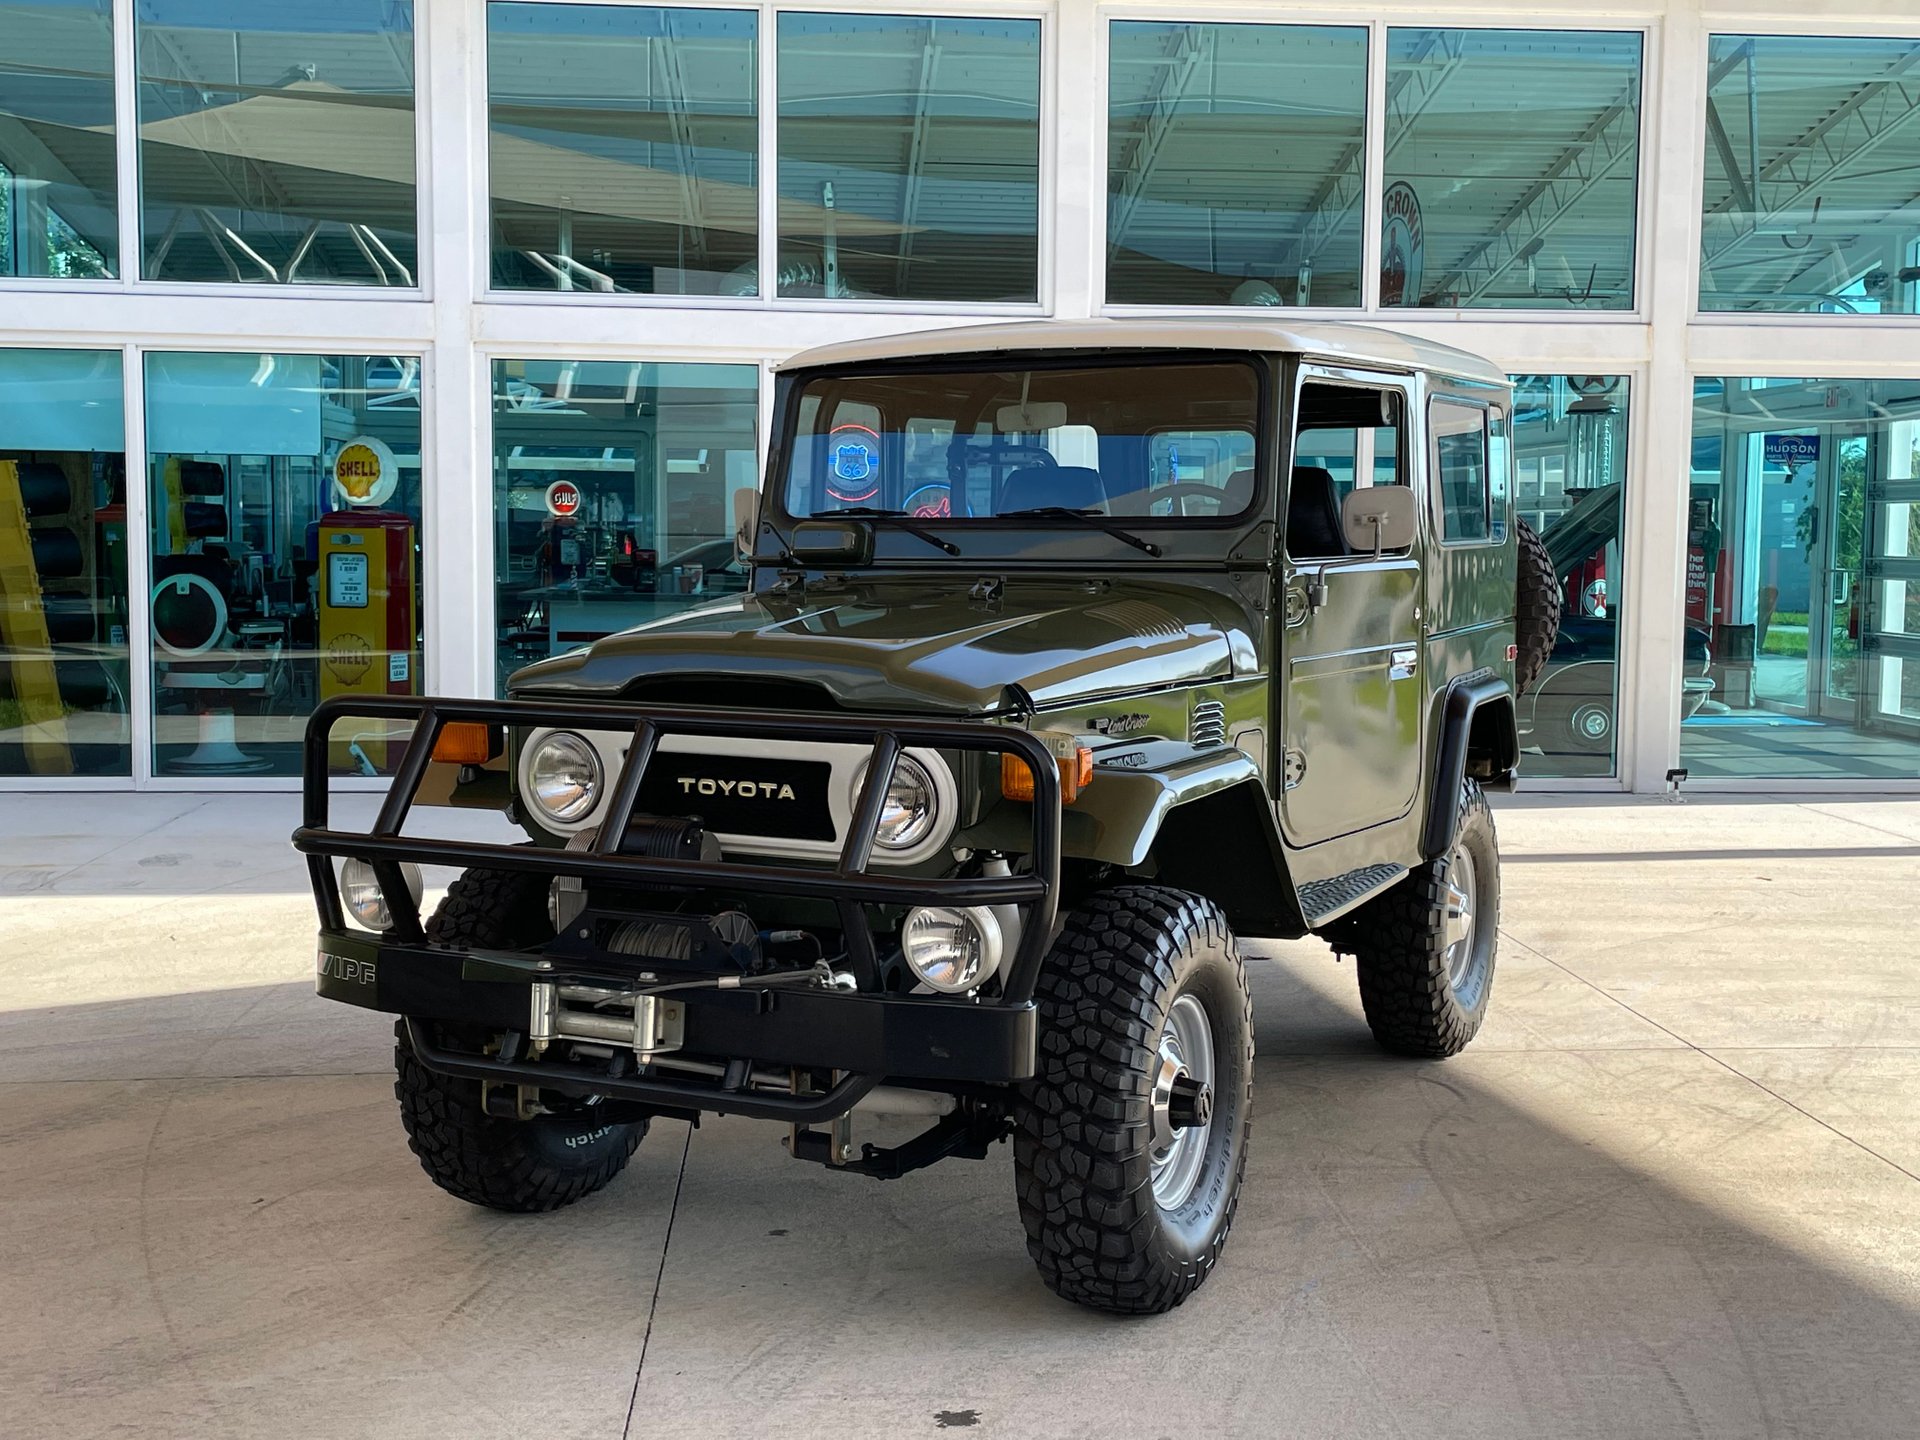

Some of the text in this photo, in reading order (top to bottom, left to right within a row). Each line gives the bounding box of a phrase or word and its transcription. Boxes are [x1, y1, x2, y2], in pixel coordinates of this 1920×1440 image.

[1386, 190, 1421, 254] CROWN
[1766, 445, 1816, 454] HUDSON
[339, 461, 377, 477] SHELL
[842, 463, 862, 477] 66
[554, 492, 577, 506] GULF
[330, 649, 368, 665] SHELL
[677, 777, 796, 801] TOYOTA
[333, 955, 376, 985] IPF
